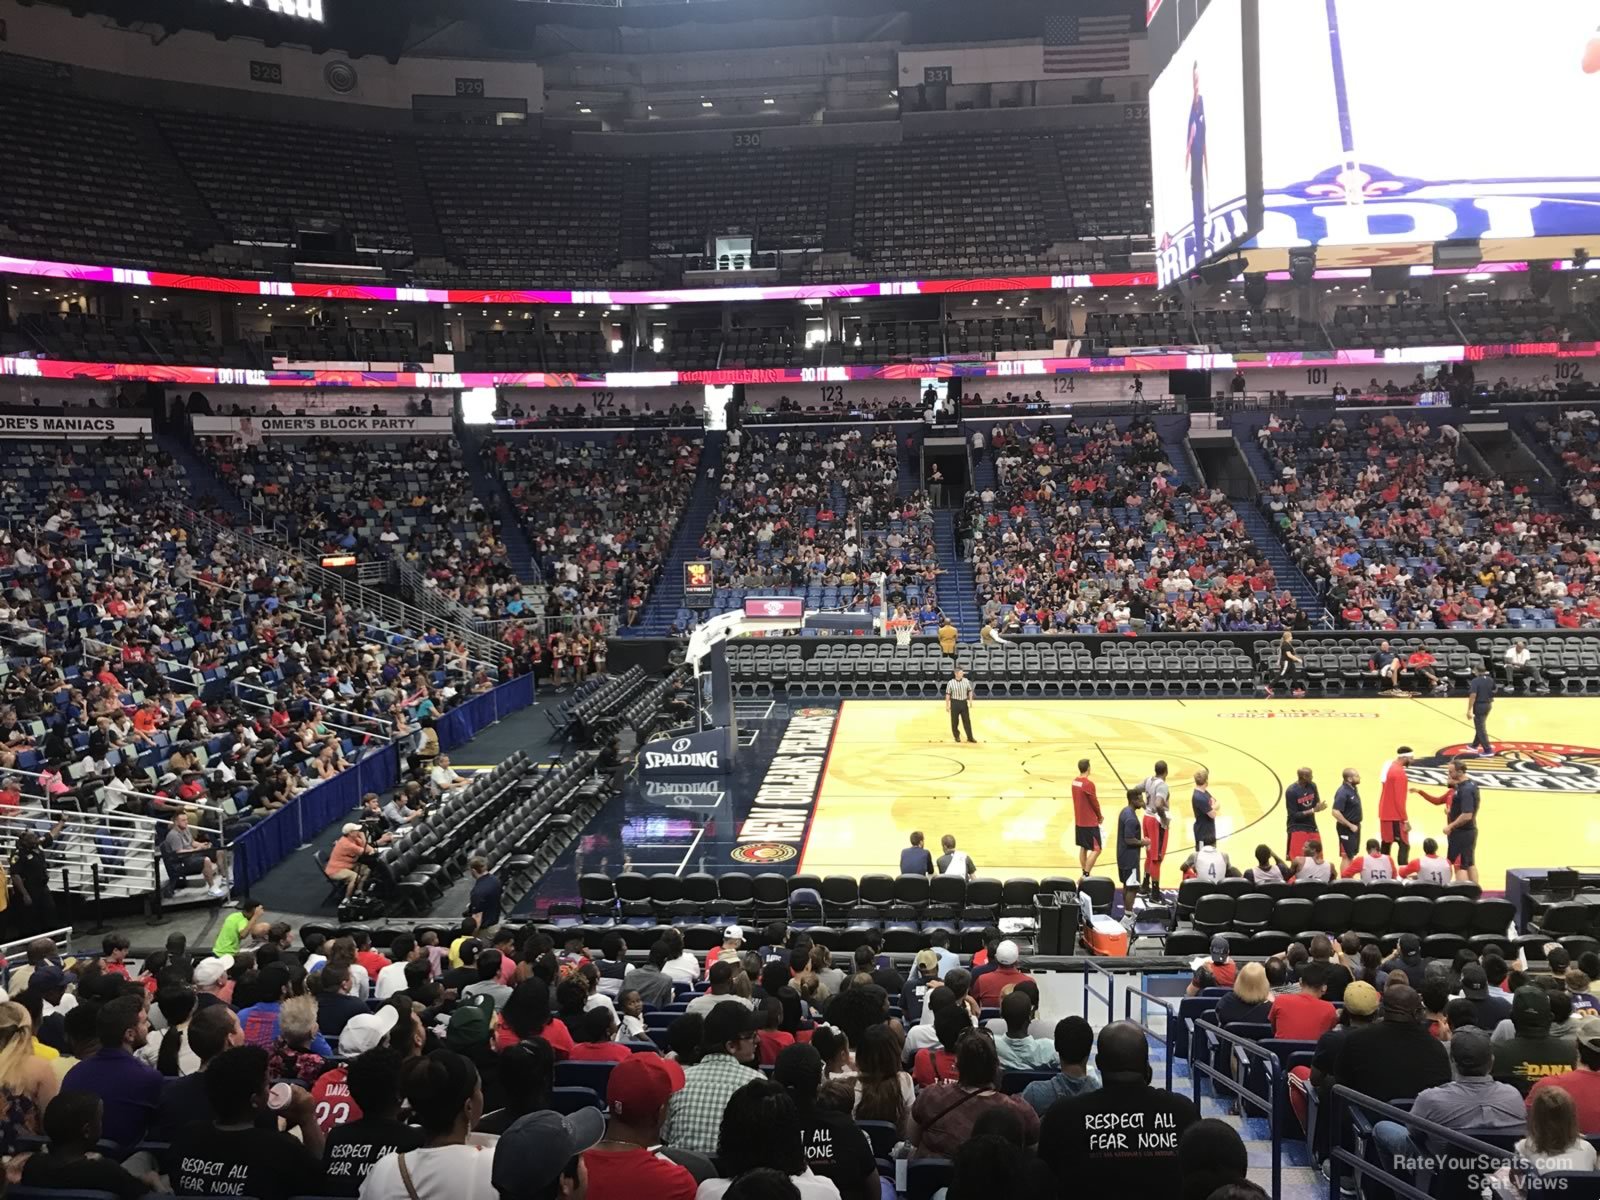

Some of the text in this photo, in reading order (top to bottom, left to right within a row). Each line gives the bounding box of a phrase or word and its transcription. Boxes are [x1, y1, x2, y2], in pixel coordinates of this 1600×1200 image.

[252, 64, 281, 81] 328
[927, 70, 949, 83] 331
[456, 80, 484, 94] 329
[734, 134, 761, 147] 330
[217, 368, 233, 384] DO
[234, 369, 245, 384] IT
[1306, 368, 1328, 384] 101
[1554, 363, 1579, 379] 102
[820, 385, 843, 402] 123
[1053, 377, 1075, 394] 124
[591, 391, 614, 408] 122
[43, 418, 115, 431] MANIACS
[261, 419, 415, 430] OMER'S BLOCK PARTY
[776, 716, 835, 754] PELICANS
[645, 750, 719, 769] SPALDING
[754, 755, 824, 805] ORLEANS
[736, 807, 809, 842] NEW
[1207, 862, 1217, 879] 4
[1085, 1112, 1176, 1130] RESPECT ALL
[812, 1128, 832, 1143] ALL
[1090, 1132, 1178, 1151] FEAR NONE
[331, 1144, 373, 1158] RESPECT
[181, 1157, 249, 1179] RESPECT ALL
[326, 1162, 376, 1176] FEAR NO
[180, 1175, 246, 1196] FEAR NONE
